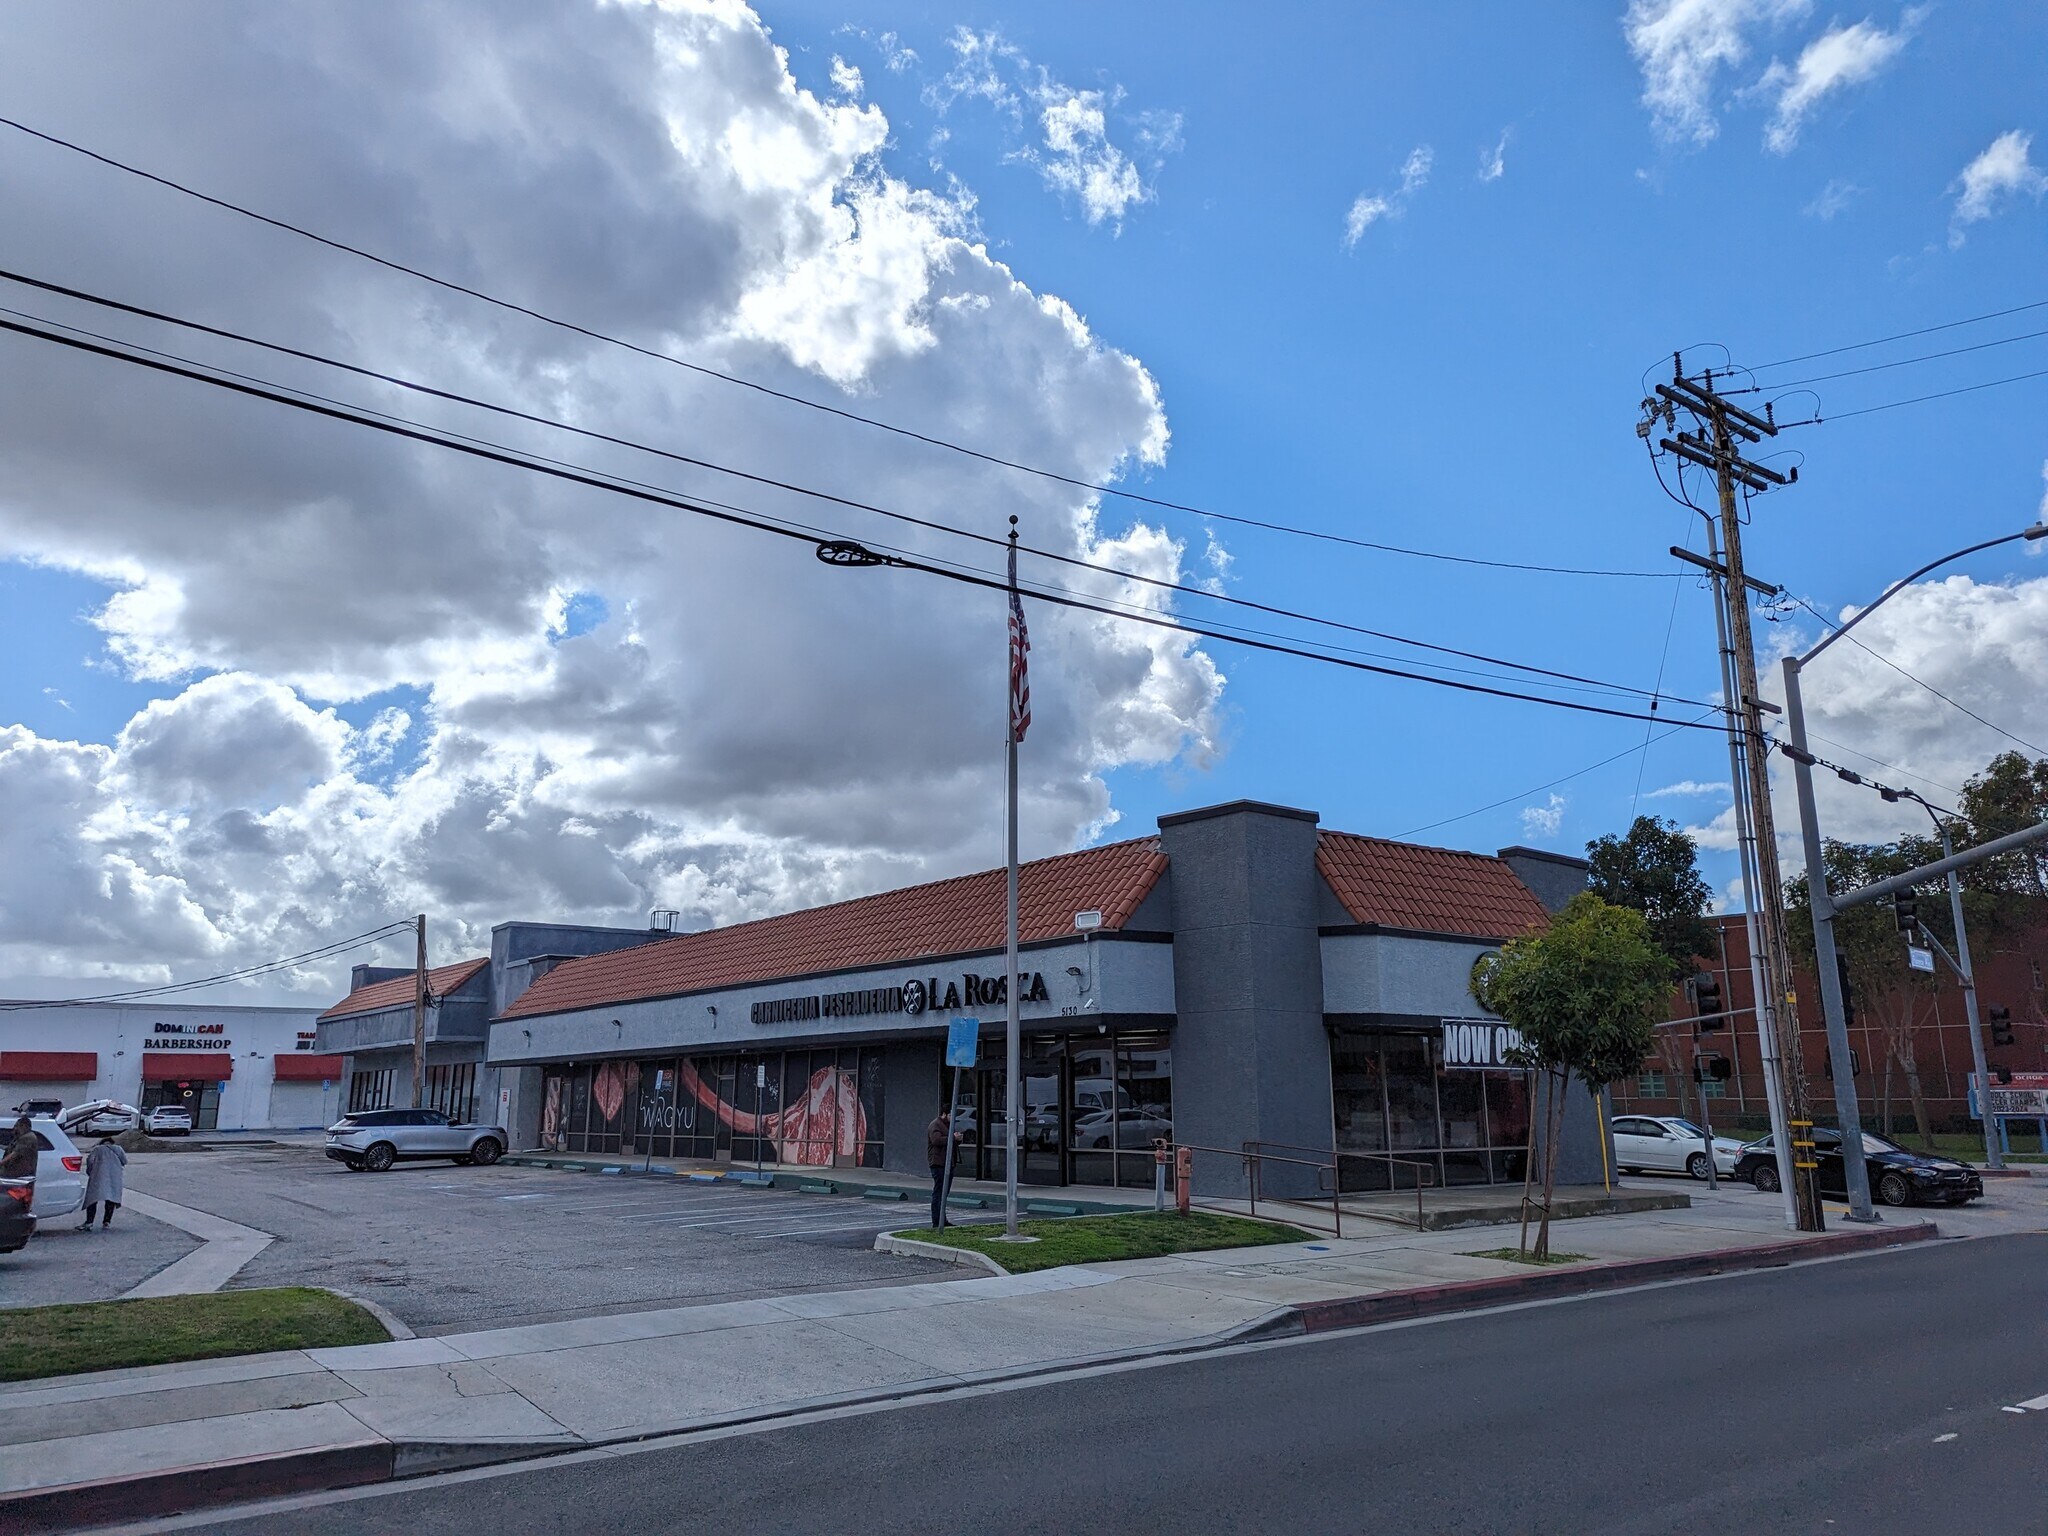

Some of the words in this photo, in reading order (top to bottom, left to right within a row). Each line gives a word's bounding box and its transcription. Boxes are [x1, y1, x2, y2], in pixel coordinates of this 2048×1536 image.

[927, 977, 961, 1011] LA
[962, 972, 1050, 1006] ROSCA
[750, 995, 819, 1024] CARNICERIA
[821, 986, 899, 1017] PESCADERIA
[1061, 1006, 1078, 1016] 5130
[154, 1022, 224, 1034] DOMINICAN
[143, 1038, 232, 1050] BARBERSHOP
[1445, 1024, 1491, 1064] NOW
[1495, 1026, 1539, 1064] OP
[640, 1104, 694, 1129] WAGYU
